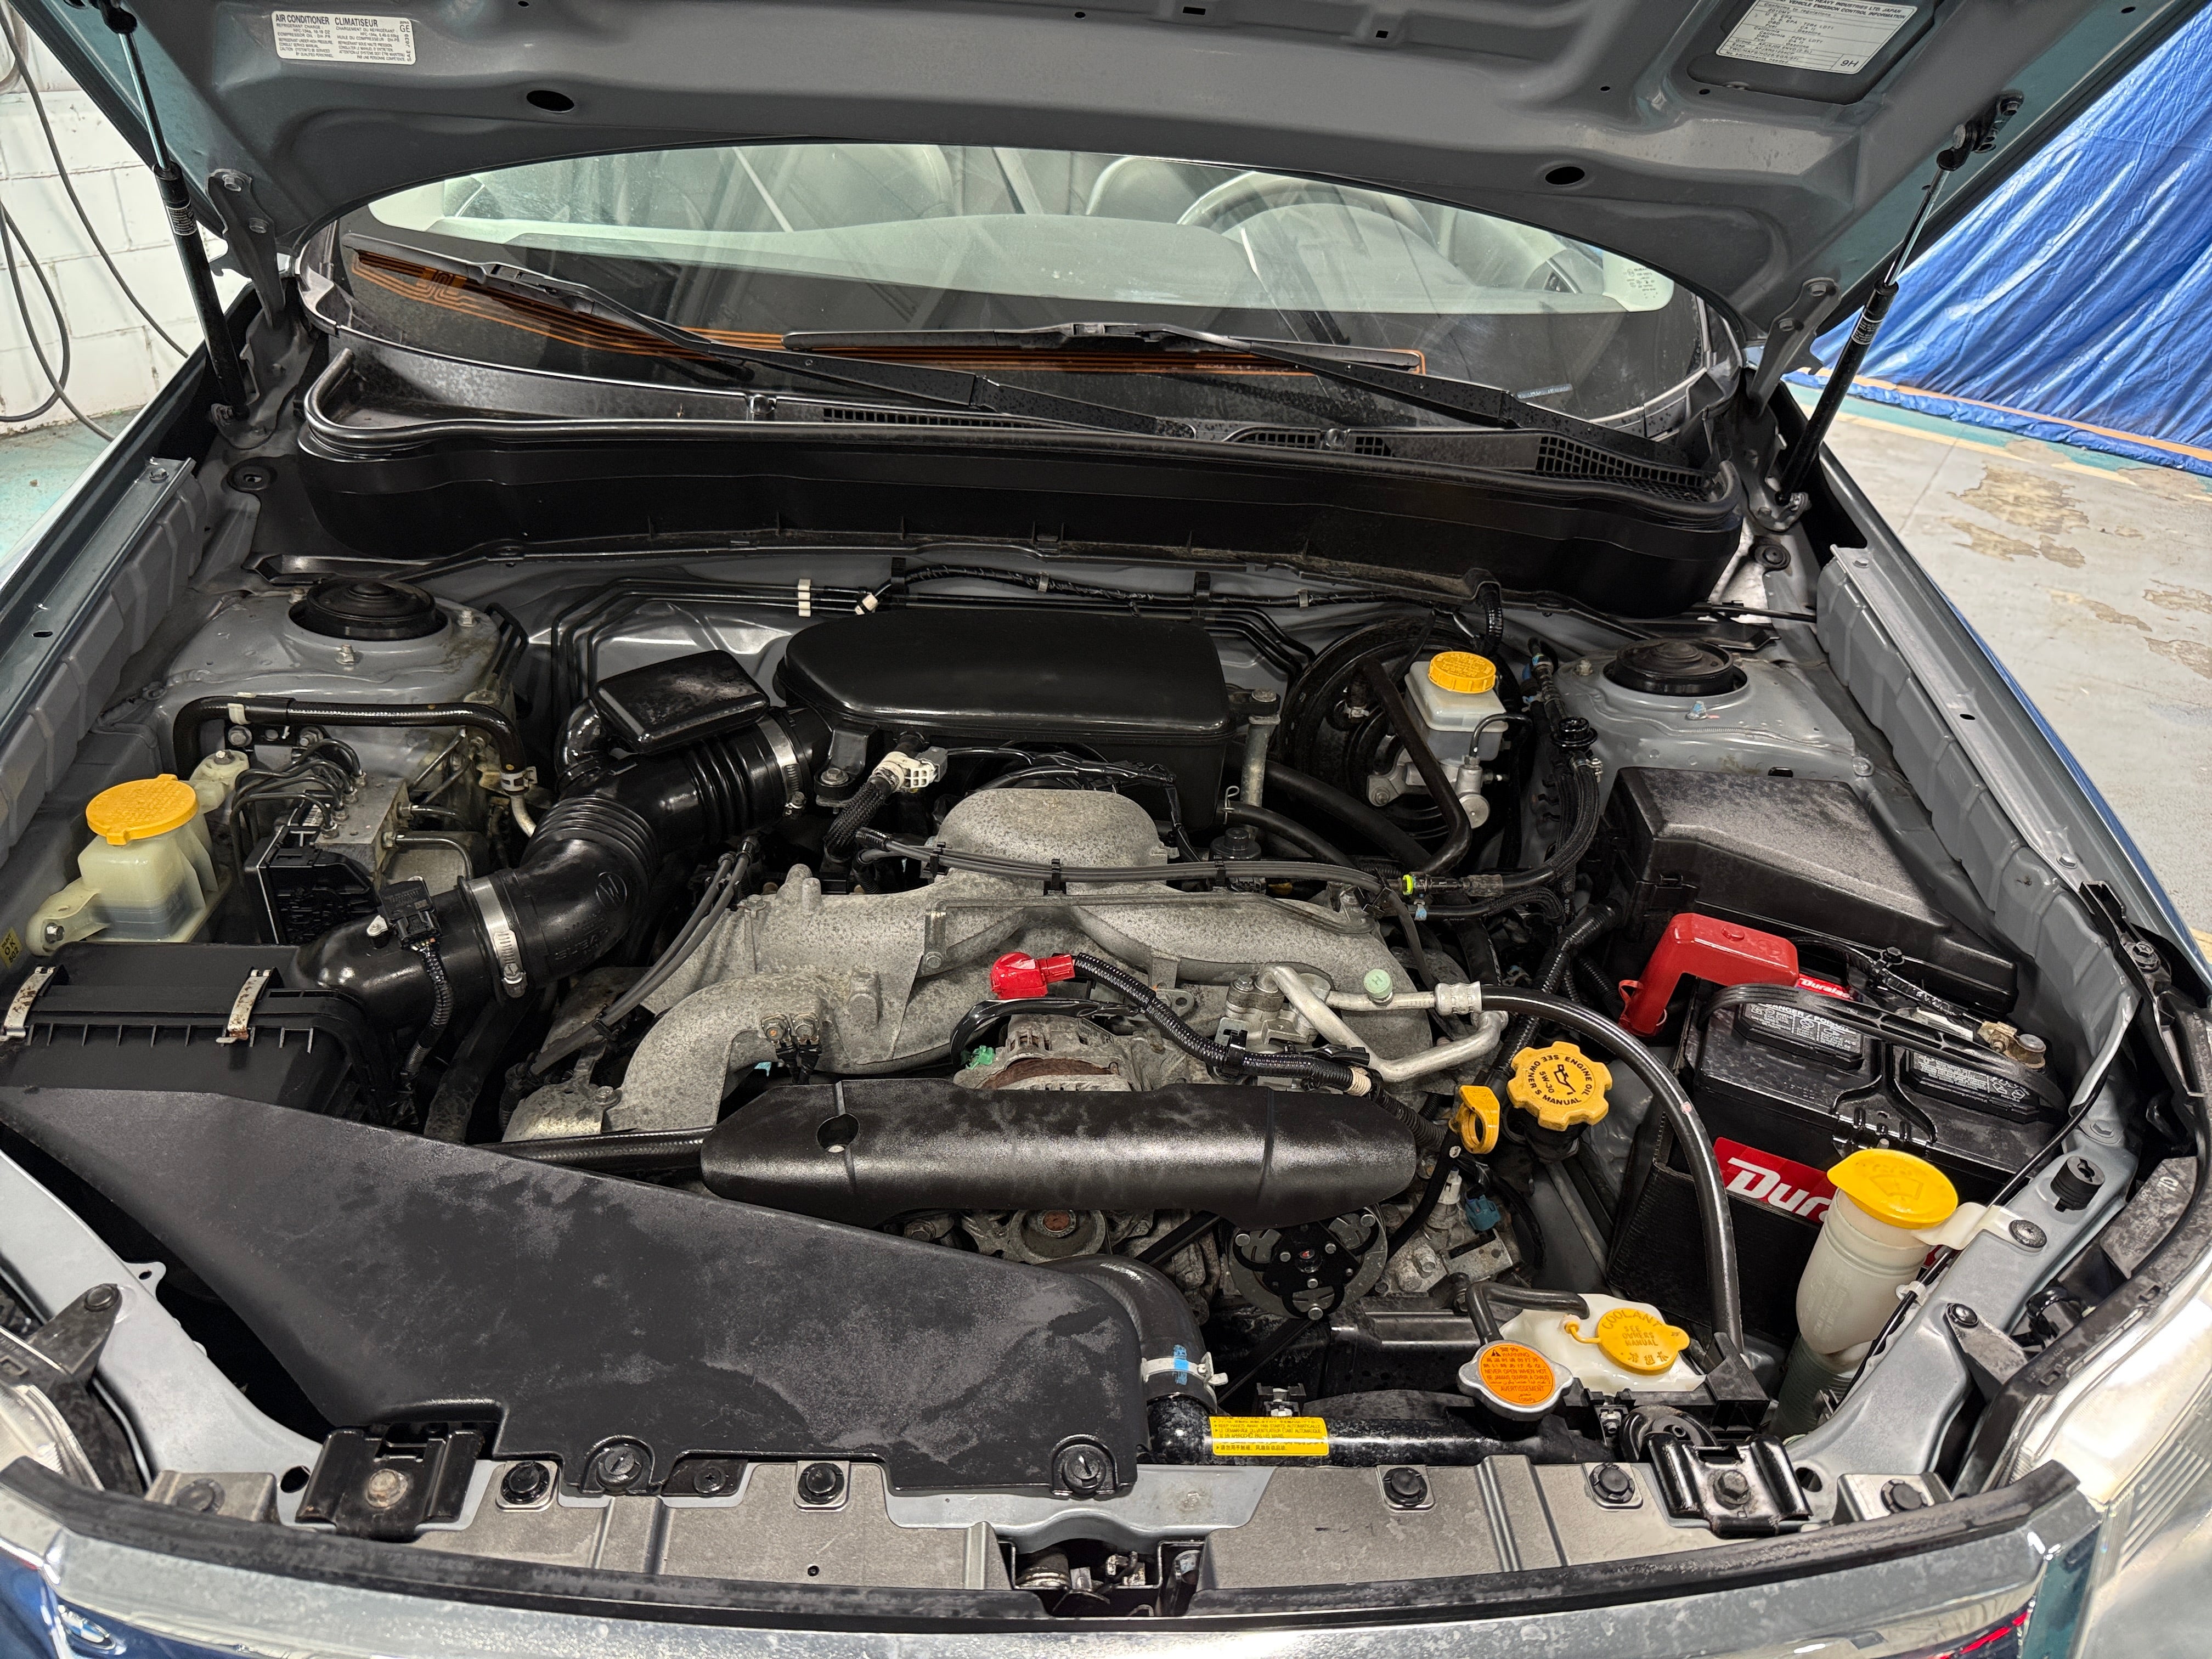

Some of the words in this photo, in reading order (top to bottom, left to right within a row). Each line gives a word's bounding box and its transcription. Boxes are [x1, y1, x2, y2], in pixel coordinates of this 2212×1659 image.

[1813, 3, 1840, 12] EMISSION
[1835, 1, 1867, 9] INDUSTRIES
[276, 14, 286, 22] AIR
[287, 15, 330, 25] CONDITIONER
[335, 17, 378, 27] CLIMATISEUR
[400, 25, 410, 33] GE
[1527, 1060, 1542, 1095] OWNER'S
[1542, 1094, 1582, 1105] MANUAL
[1539, 1071, 1555, 1093] 5W-30
[1565, 1056, 1593, 1082] ENGINE
[1581, 1084, 1593, 1095] OIL
[1726, 1157, 1832, 1222] Dur
[1601, 1310, 1662, 1329] COOLANT
